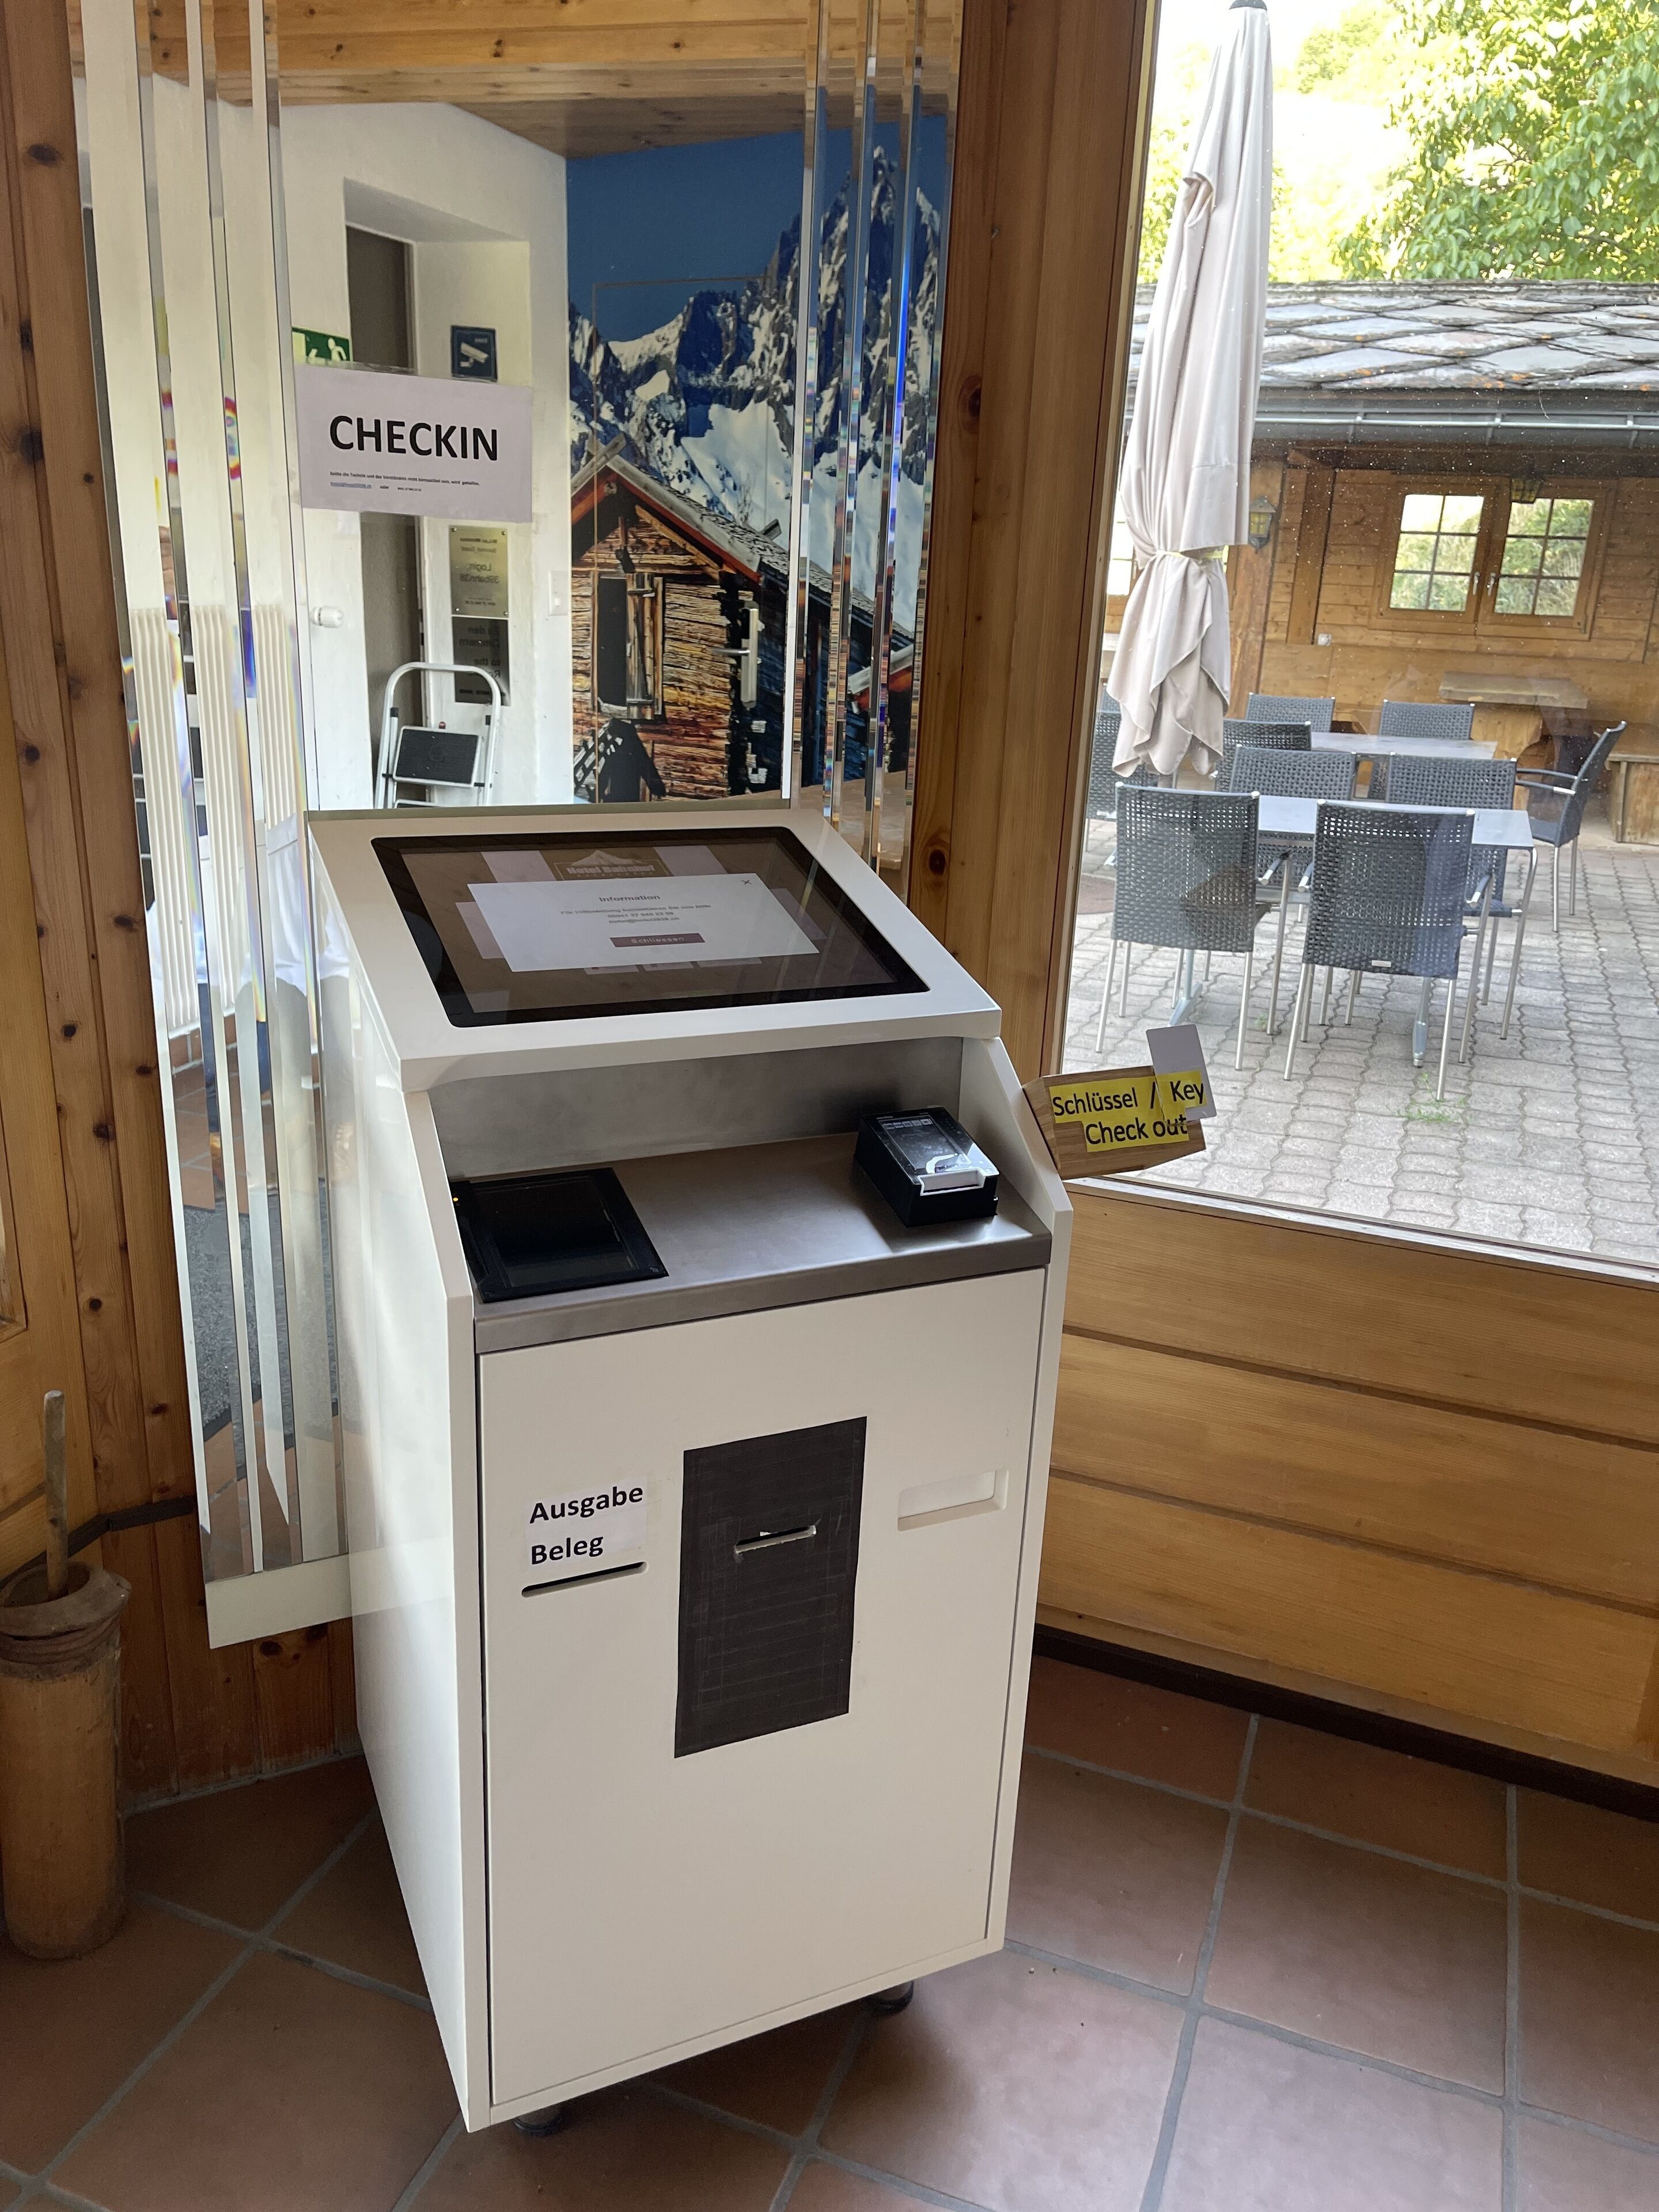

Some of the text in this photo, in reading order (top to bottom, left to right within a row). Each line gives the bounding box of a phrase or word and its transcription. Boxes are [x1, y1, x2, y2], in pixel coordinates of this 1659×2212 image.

[330, 415, 497, 461] CHECKIN
[602, 865, 656, 873] Bahnhof
[631, 935, 684, 945] Schliessen
[1053, 1081, 1204, 1116] Schlüssel / Key
[1085, 1114, 1188, 1145] Check out
[529, 1486, 643, 1524] Ausgabe
[531, 1536, 604, 1565] Beleg
